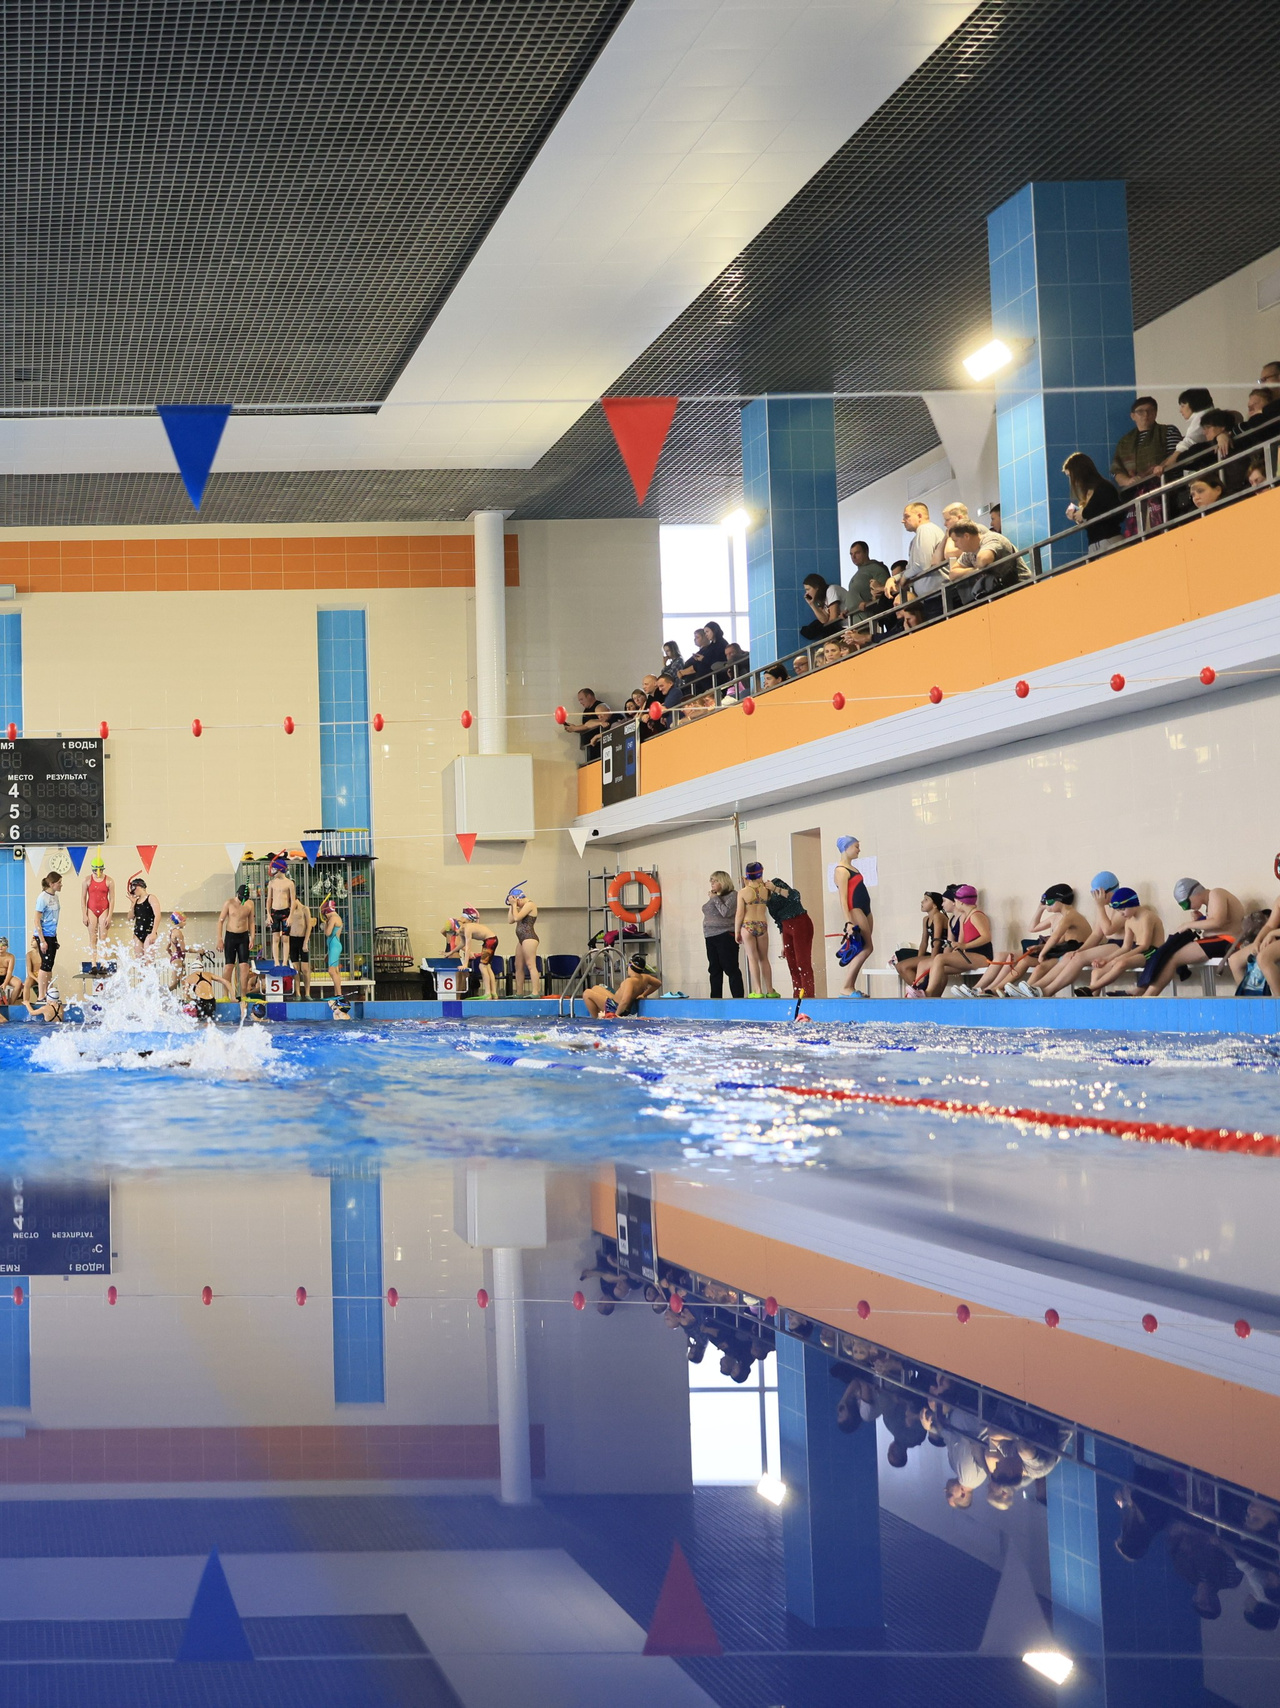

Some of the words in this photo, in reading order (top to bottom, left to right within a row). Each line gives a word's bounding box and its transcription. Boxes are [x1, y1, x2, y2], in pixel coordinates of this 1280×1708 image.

[68, 741, 98, 751] ВОДЫ
[46, 773, 88, 781] РЕЗУЛЬТАТ
[8, 782, 20, 798] 4
[9, 804, 20, 819] 5
[9, 825, 20, 840] 6
[271, 980, 280, 992] 5
[443, 978, 453, 990] 6
